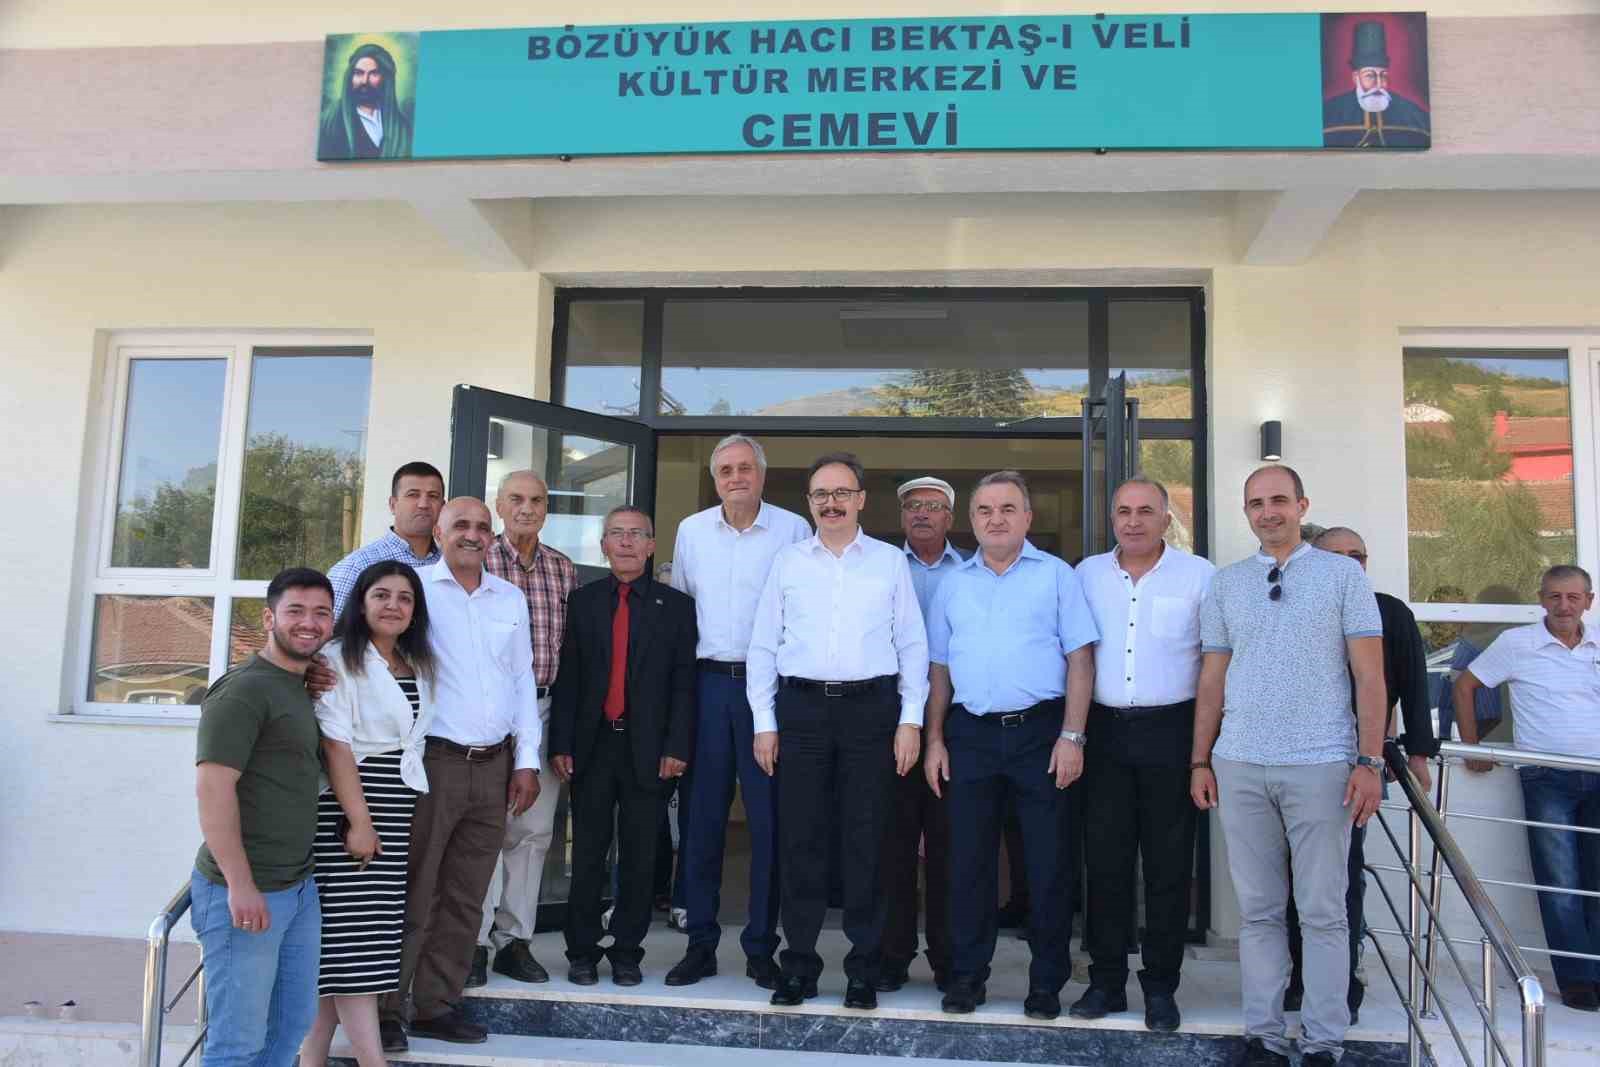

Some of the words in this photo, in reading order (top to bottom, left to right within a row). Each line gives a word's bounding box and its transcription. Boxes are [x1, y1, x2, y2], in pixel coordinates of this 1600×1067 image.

[751, 26, 851, 54] HACI
[871, 23, 1072, 57] BEKTAŞ-I
[1091, 16, 1191, 49] VELİ
[618, 64, 790, 97] KÜLTÜR
[807, 59, 1002, 93] MERKEZİ
[1020, 64, 1077, 91] VE
[742, 103, 958, 148] CEMEVİ
